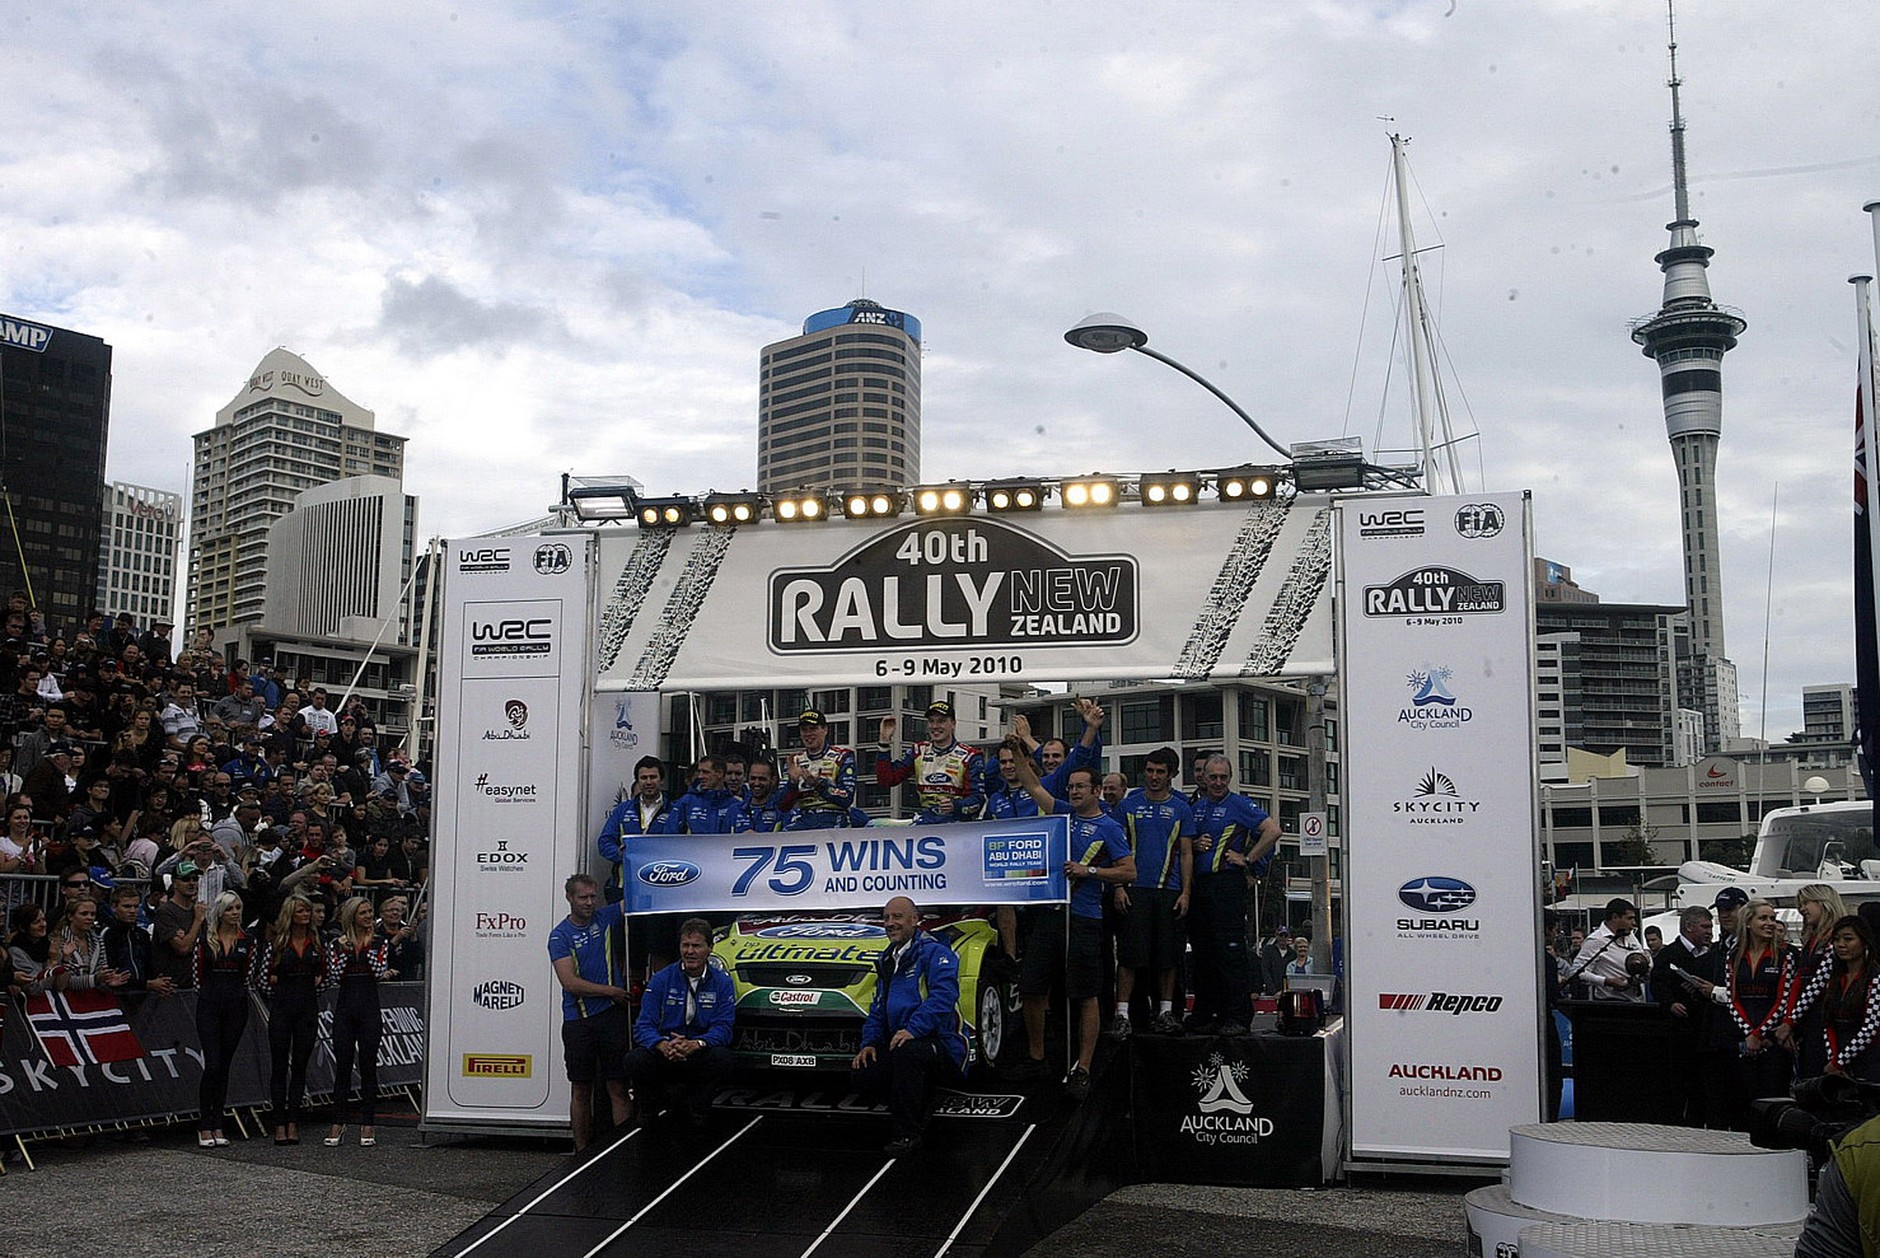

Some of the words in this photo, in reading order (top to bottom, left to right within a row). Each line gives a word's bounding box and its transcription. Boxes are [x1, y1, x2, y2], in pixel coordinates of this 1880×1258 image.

[854, 312, 885, 324] ANZ
[305, 376, 323, 389] WEST
[1360, 510, 1424, 526] WRC
[895, 529, 988, 565] 40th
[460, 549, 510, 562] WRC
[1413, 571, 1449, 585] 40th
[781, 572, 1004, 643] RALLY
[1011, 567, 1121, 613] NEW
[1368, 586, 1455, 614] RALLY
[1456, 584, 1499, 602] NEW
[1457, 601, 1500, 611] ZEALAND
[472, 619, 552, 640] WRC
[1010, 613, 1121, 637] ZEALAND
[1424, 618, 1440, 627] May
[1442, 617, 1463, 625] 2010
[922, 659, 963, 679] May
[969, 657, 1022, 675] 2010
[1397, 708, 1473, 723] AUCKLAND
[1410, 720, 1428, 731] City
[1429, 719, 1460, 729] Council
[1393, 802, 1480, 812] SKYCITY
[988, 841, 1006, 851] BP
[1008, 840, 1042, 850] FORD
[476, 853, 528, 863] EDOX
[989, 852, 1009, 861] ABU
[1011, 850, 1042, 860] DHABI
[649, 863, 688, 883] Ford
[731, 845, 818, 898] 75
[825, 836, 947, 872] WINS
[824, 876, 858, 893] AND
[862, 873, 947, 892] COUNTING
[476, 913, 526, 930] FxPro
[1396, 919, 1480, 932] SUBARU
[777, 926, 869, 938] Ford
[735, 943, 885, 961] ultimate
[780, 992, 815, 1003] Castrol
[1426, 993, 1503, 1016] Repco
[468, 1058, 526, 1074] PIRELLI
[796, 1057, 815, 1065] AXB
[1388, 1064, 1503, 1081] AUCKLAND
[1399, 1085, 1492, 1099] aucklandnz.com
[712, 1089, 888, 1112] RALL
[1180, 1115, 1274, 1136] AUCKLAND
[1196, 1131, 1217, 1146] City
[1219, 1132, 1258, 1144] Council
